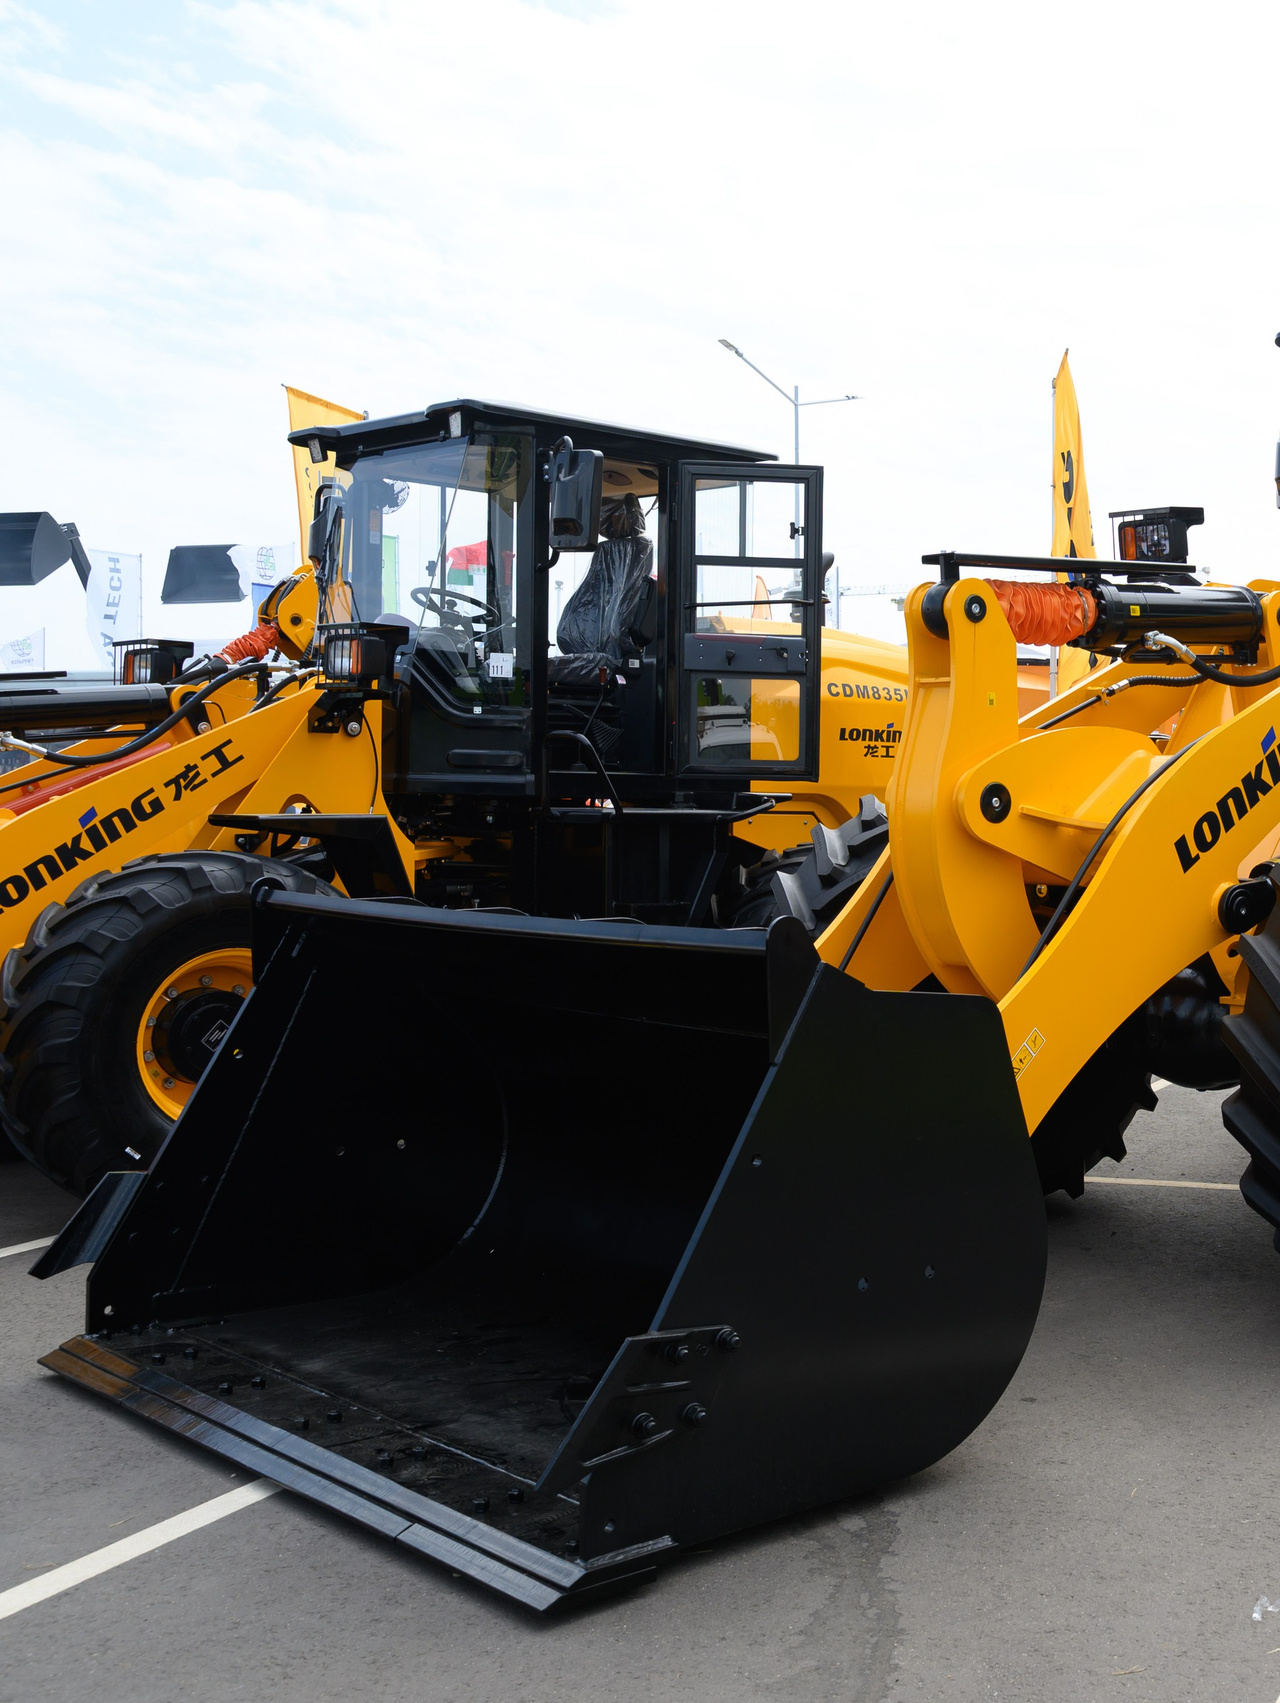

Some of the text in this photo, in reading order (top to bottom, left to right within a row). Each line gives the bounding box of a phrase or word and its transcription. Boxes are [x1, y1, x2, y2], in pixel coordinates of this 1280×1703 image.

[839, 722, 903, 743] LONKIN
[863, 744, 895, 759] 龙工
[0, 738, 244, 915] ONKING 龙工
